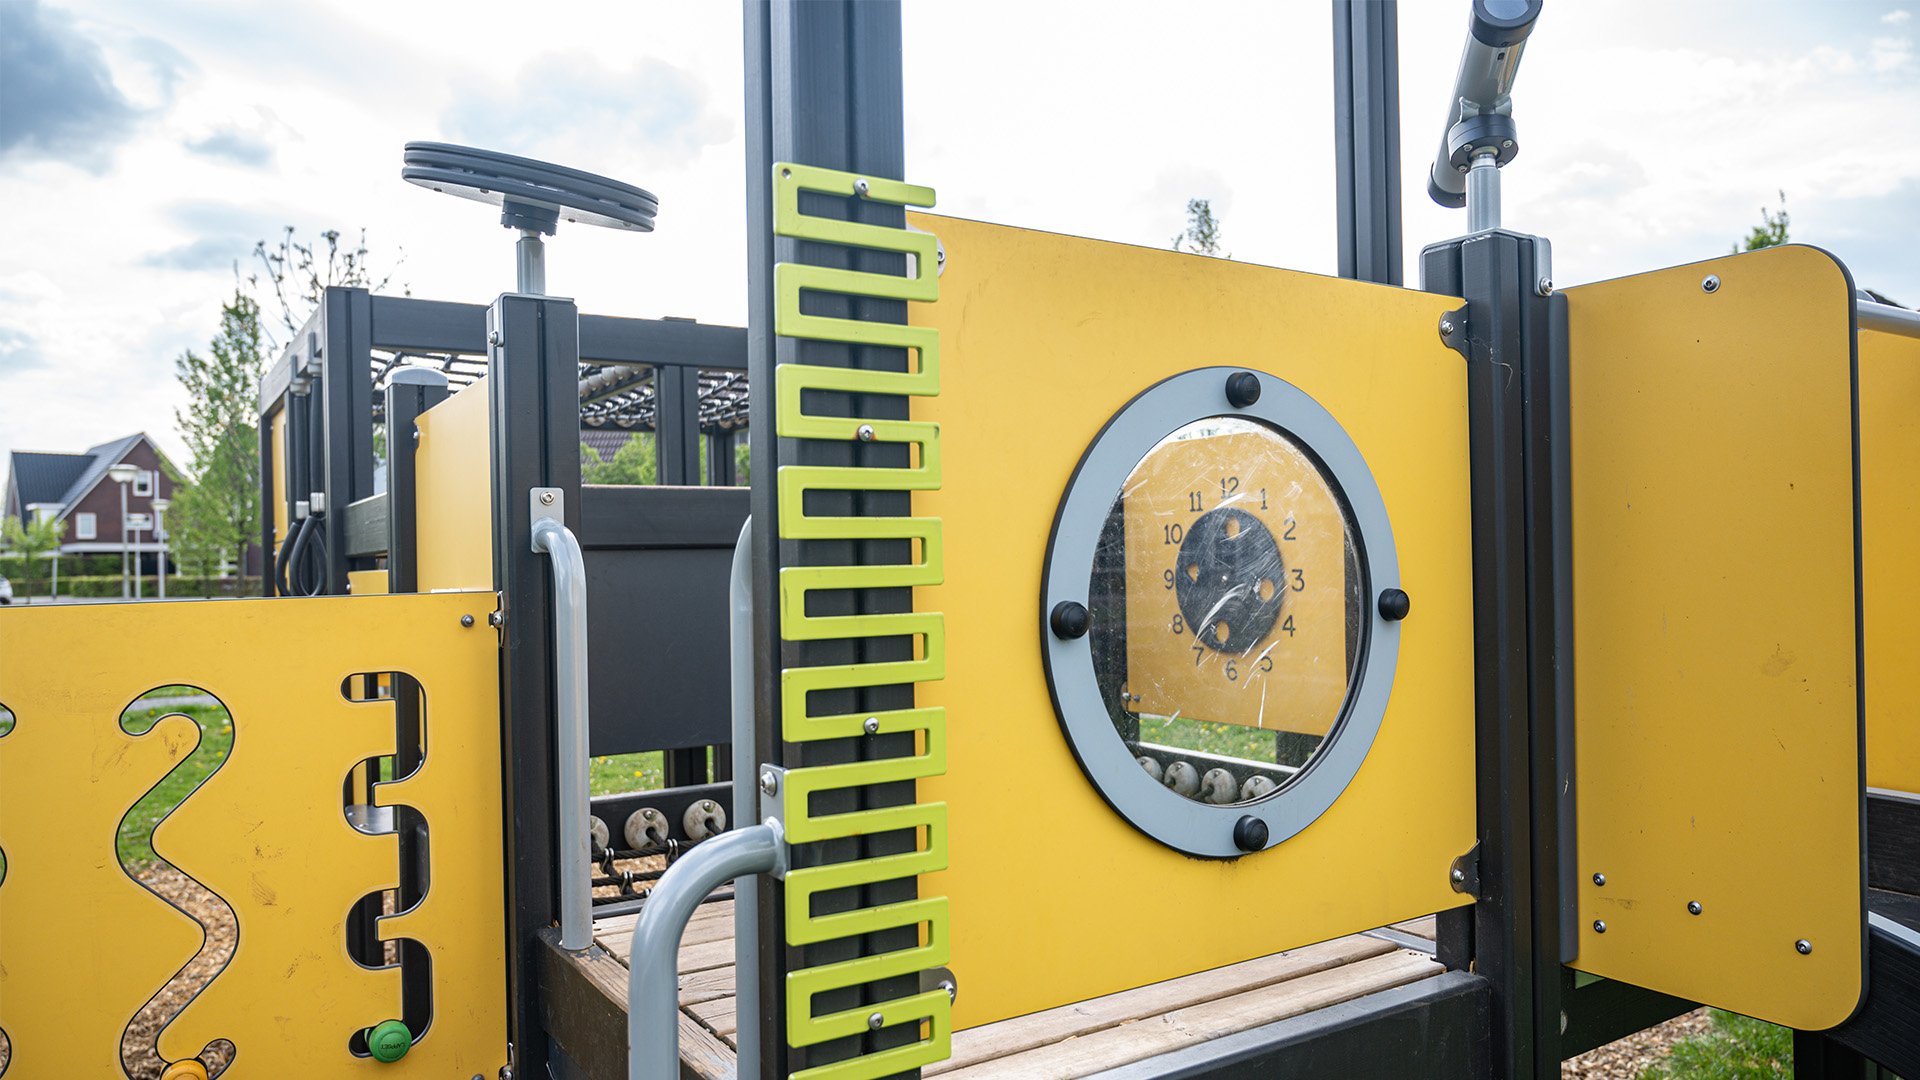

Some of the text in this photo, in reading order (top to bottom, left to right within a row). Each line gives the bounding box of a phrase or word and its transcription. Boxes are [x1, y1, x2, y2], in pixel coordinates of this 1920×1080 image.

[1220, 477, 1239, 499] 12
[1260, 488, 1268, 510] 1
[1189, 491, 1203, 512] 11
[1164, 523, 1183, 545] 10
[1283, 518, 1296, 541] 2
[1163, 569, 1175, 590] 9
[1291, 569, 1305, 592] 3
[1172, 614, 1184, 634] 8
[1282, 615, 1296, 637] 4
[1192, 646, 1205, 667] 7
[1225, 659, 1238, 681] 6
